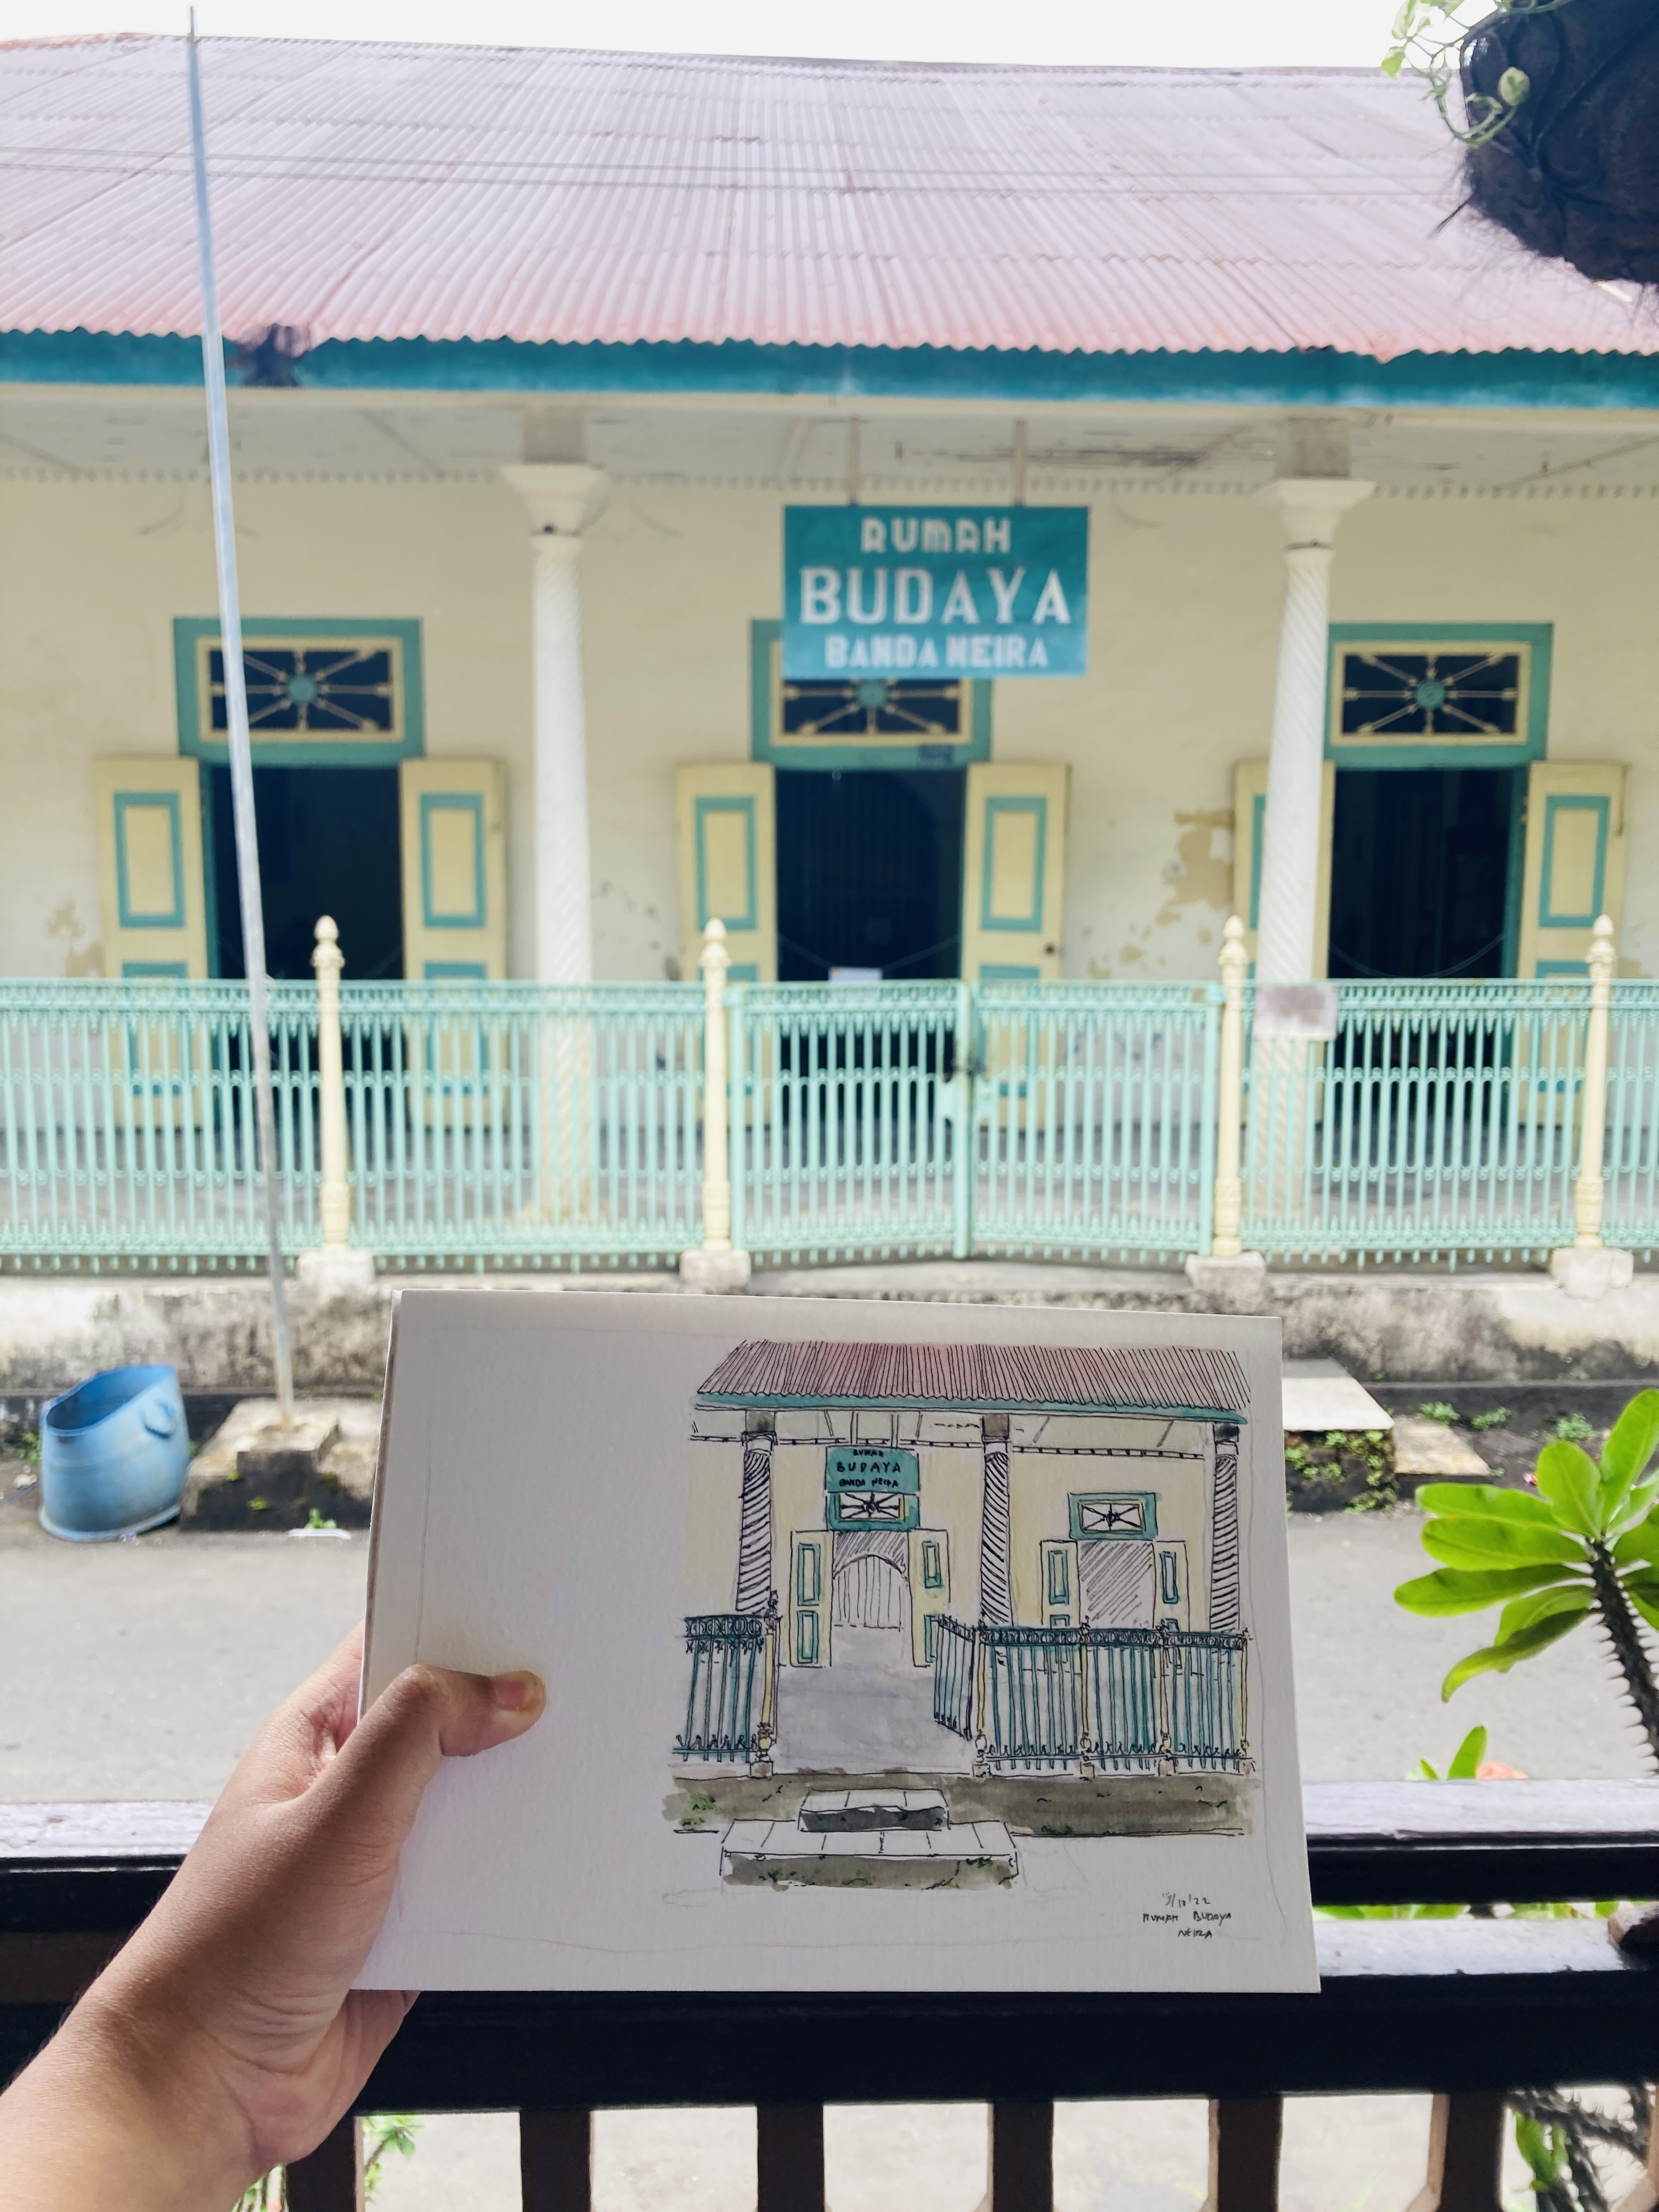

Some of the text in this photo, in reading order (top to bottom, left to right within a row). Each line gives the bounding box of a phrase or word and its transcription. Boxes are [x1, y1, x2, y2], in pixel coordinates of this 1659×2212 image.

[860, 516, 1012, 553] RUMAH
[799, 566, 1071, 625] BUDAYA
[824, 634, 1048, 669] BANDA NEIRA
[837, 1461, 901, 1473] BUDAYA
[1193, 1910, 1232, 1926] BUDAYA
[1177, 1928, 1212, 1939] NEIRA
